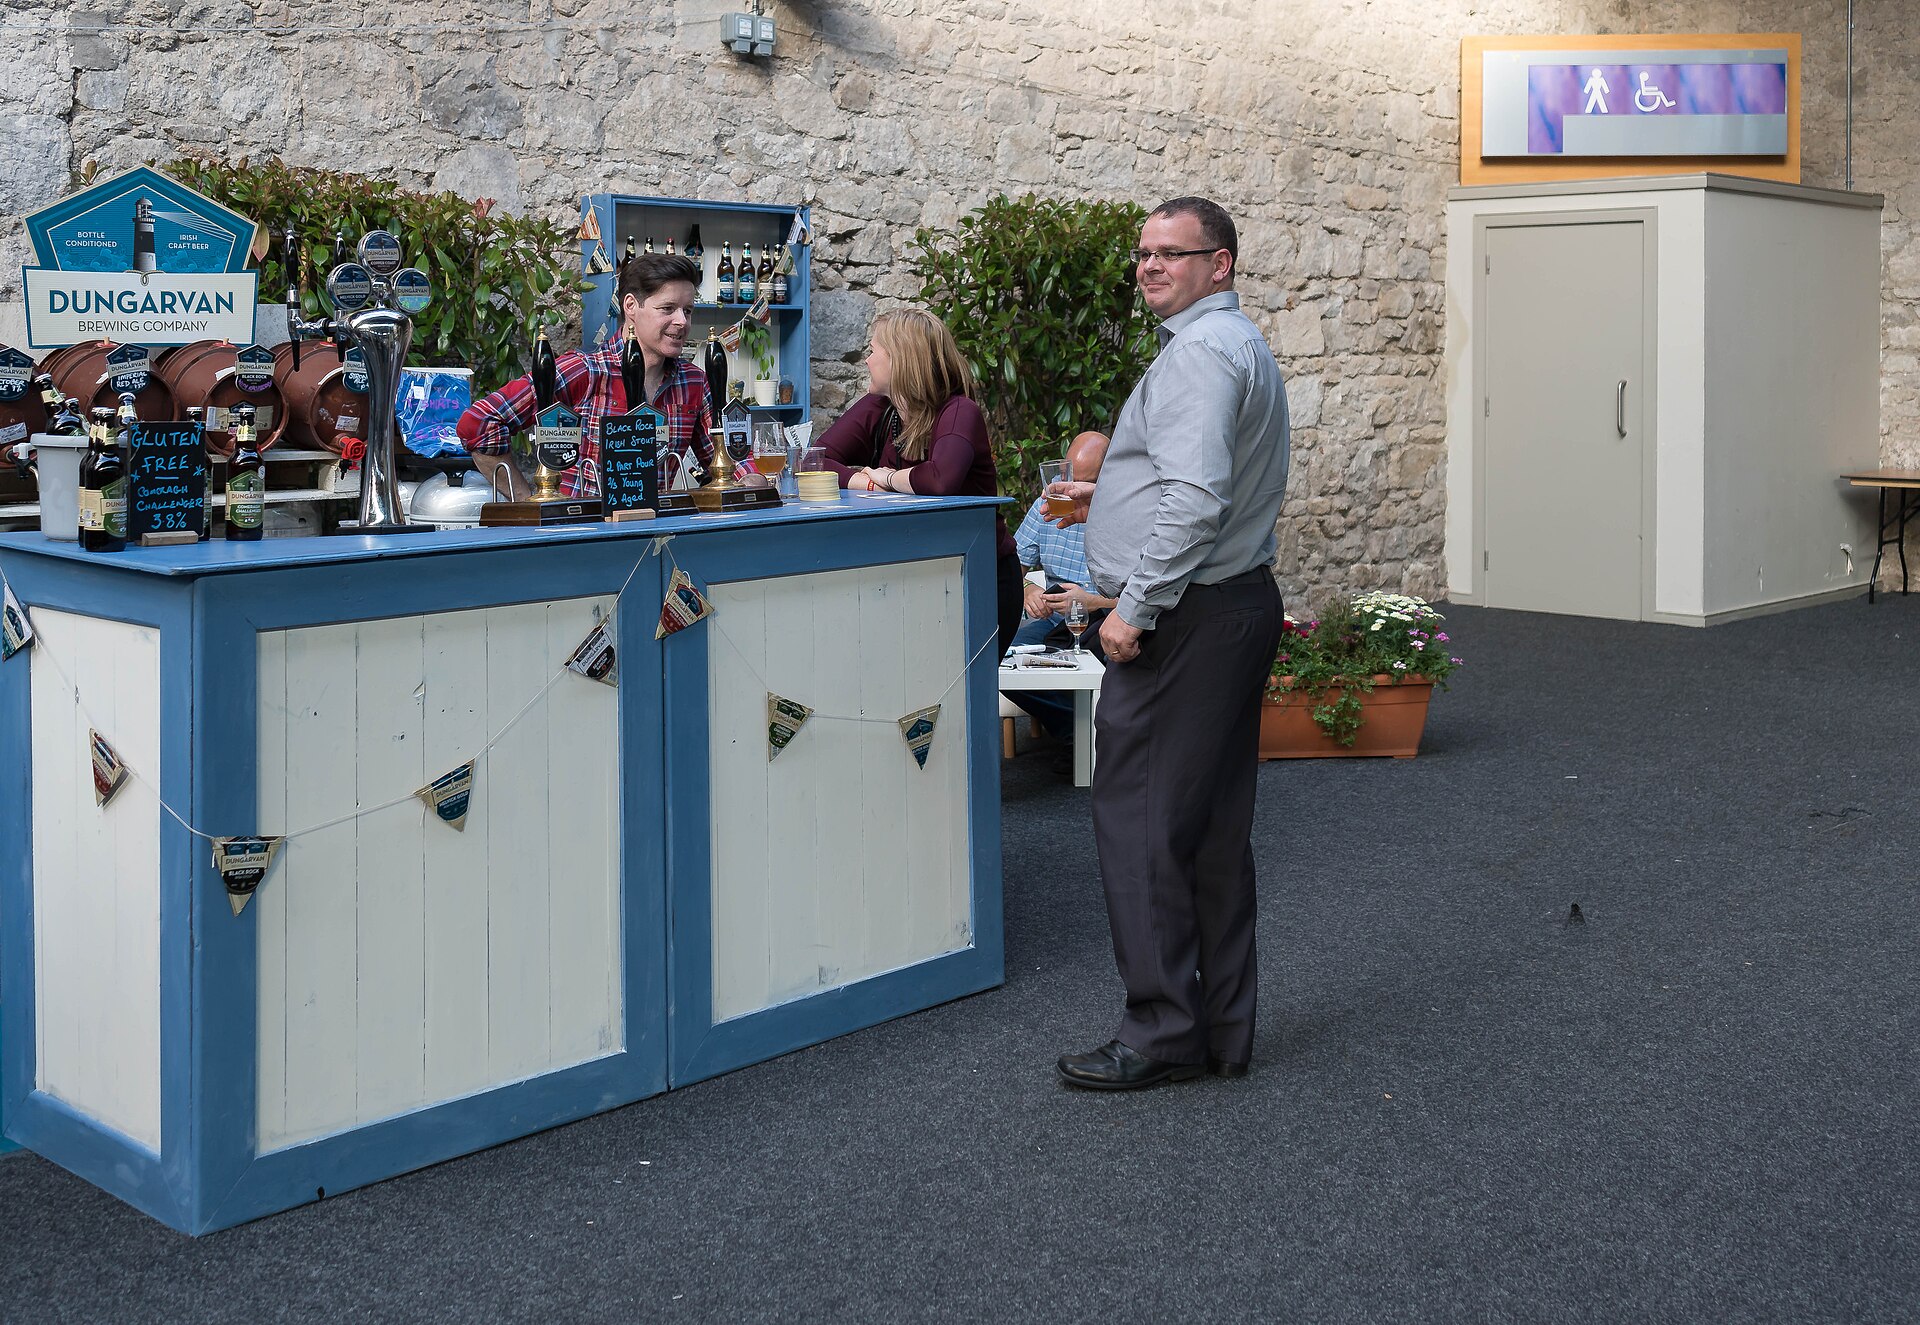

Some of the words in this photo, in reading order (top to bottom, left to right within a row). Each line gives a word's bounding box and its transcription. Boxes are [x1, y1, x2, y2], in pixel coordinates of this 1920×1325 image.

[77, 231, 105, 239] BOTTLE
[65, 239, 118, 248] CONDITIONED
[168, 242, 190, 250] CRAFT
[49, 289, 234, 314] DUNGARVAN
[78, 321, 140, 332] BREWING
[143, 321, 208, 332] COMPANY
[111, 361, 146, 371] DUNGARVAN
[117, 371, 148, 381] IMPERIAL
[0, 379, 26, 387] CTOBER
[116, 380, 131, 388] RED
[131, 377, 145, 385] ALE
[605, 422, 632, 435] BLACK
[635, 418, 655, 431] ROCK
[131, 430, 201, 448] GLUTEN
[605, 438, 626, 450] IRISH
[630, 435, 656, 447] STOUT
[562, 449, 577, 460] OLD
[141, 454, 189, 473] FREE
[606, 459, 614, 473] 2
[616, 460, 633, 472] PART
[636, 456, 655, 469] POUR
[607, 476, 618, 490] 2/3
[622, 476, 644, 492] Young
[136, 497, 204, 512] CHALLENGER
[607, 492, 618, 506] 1/3
[671, 595, 695, 621] DUNGARVAN
[581, 638, 607, 667] DUNGARVAN
[435, 779, 469, 798] DUNGARVAN
[456, 790, 469, 799] GOLD
[225, 855, 265, 865] DUNGARVAN
[228, 869, 244, 877] BLACK
